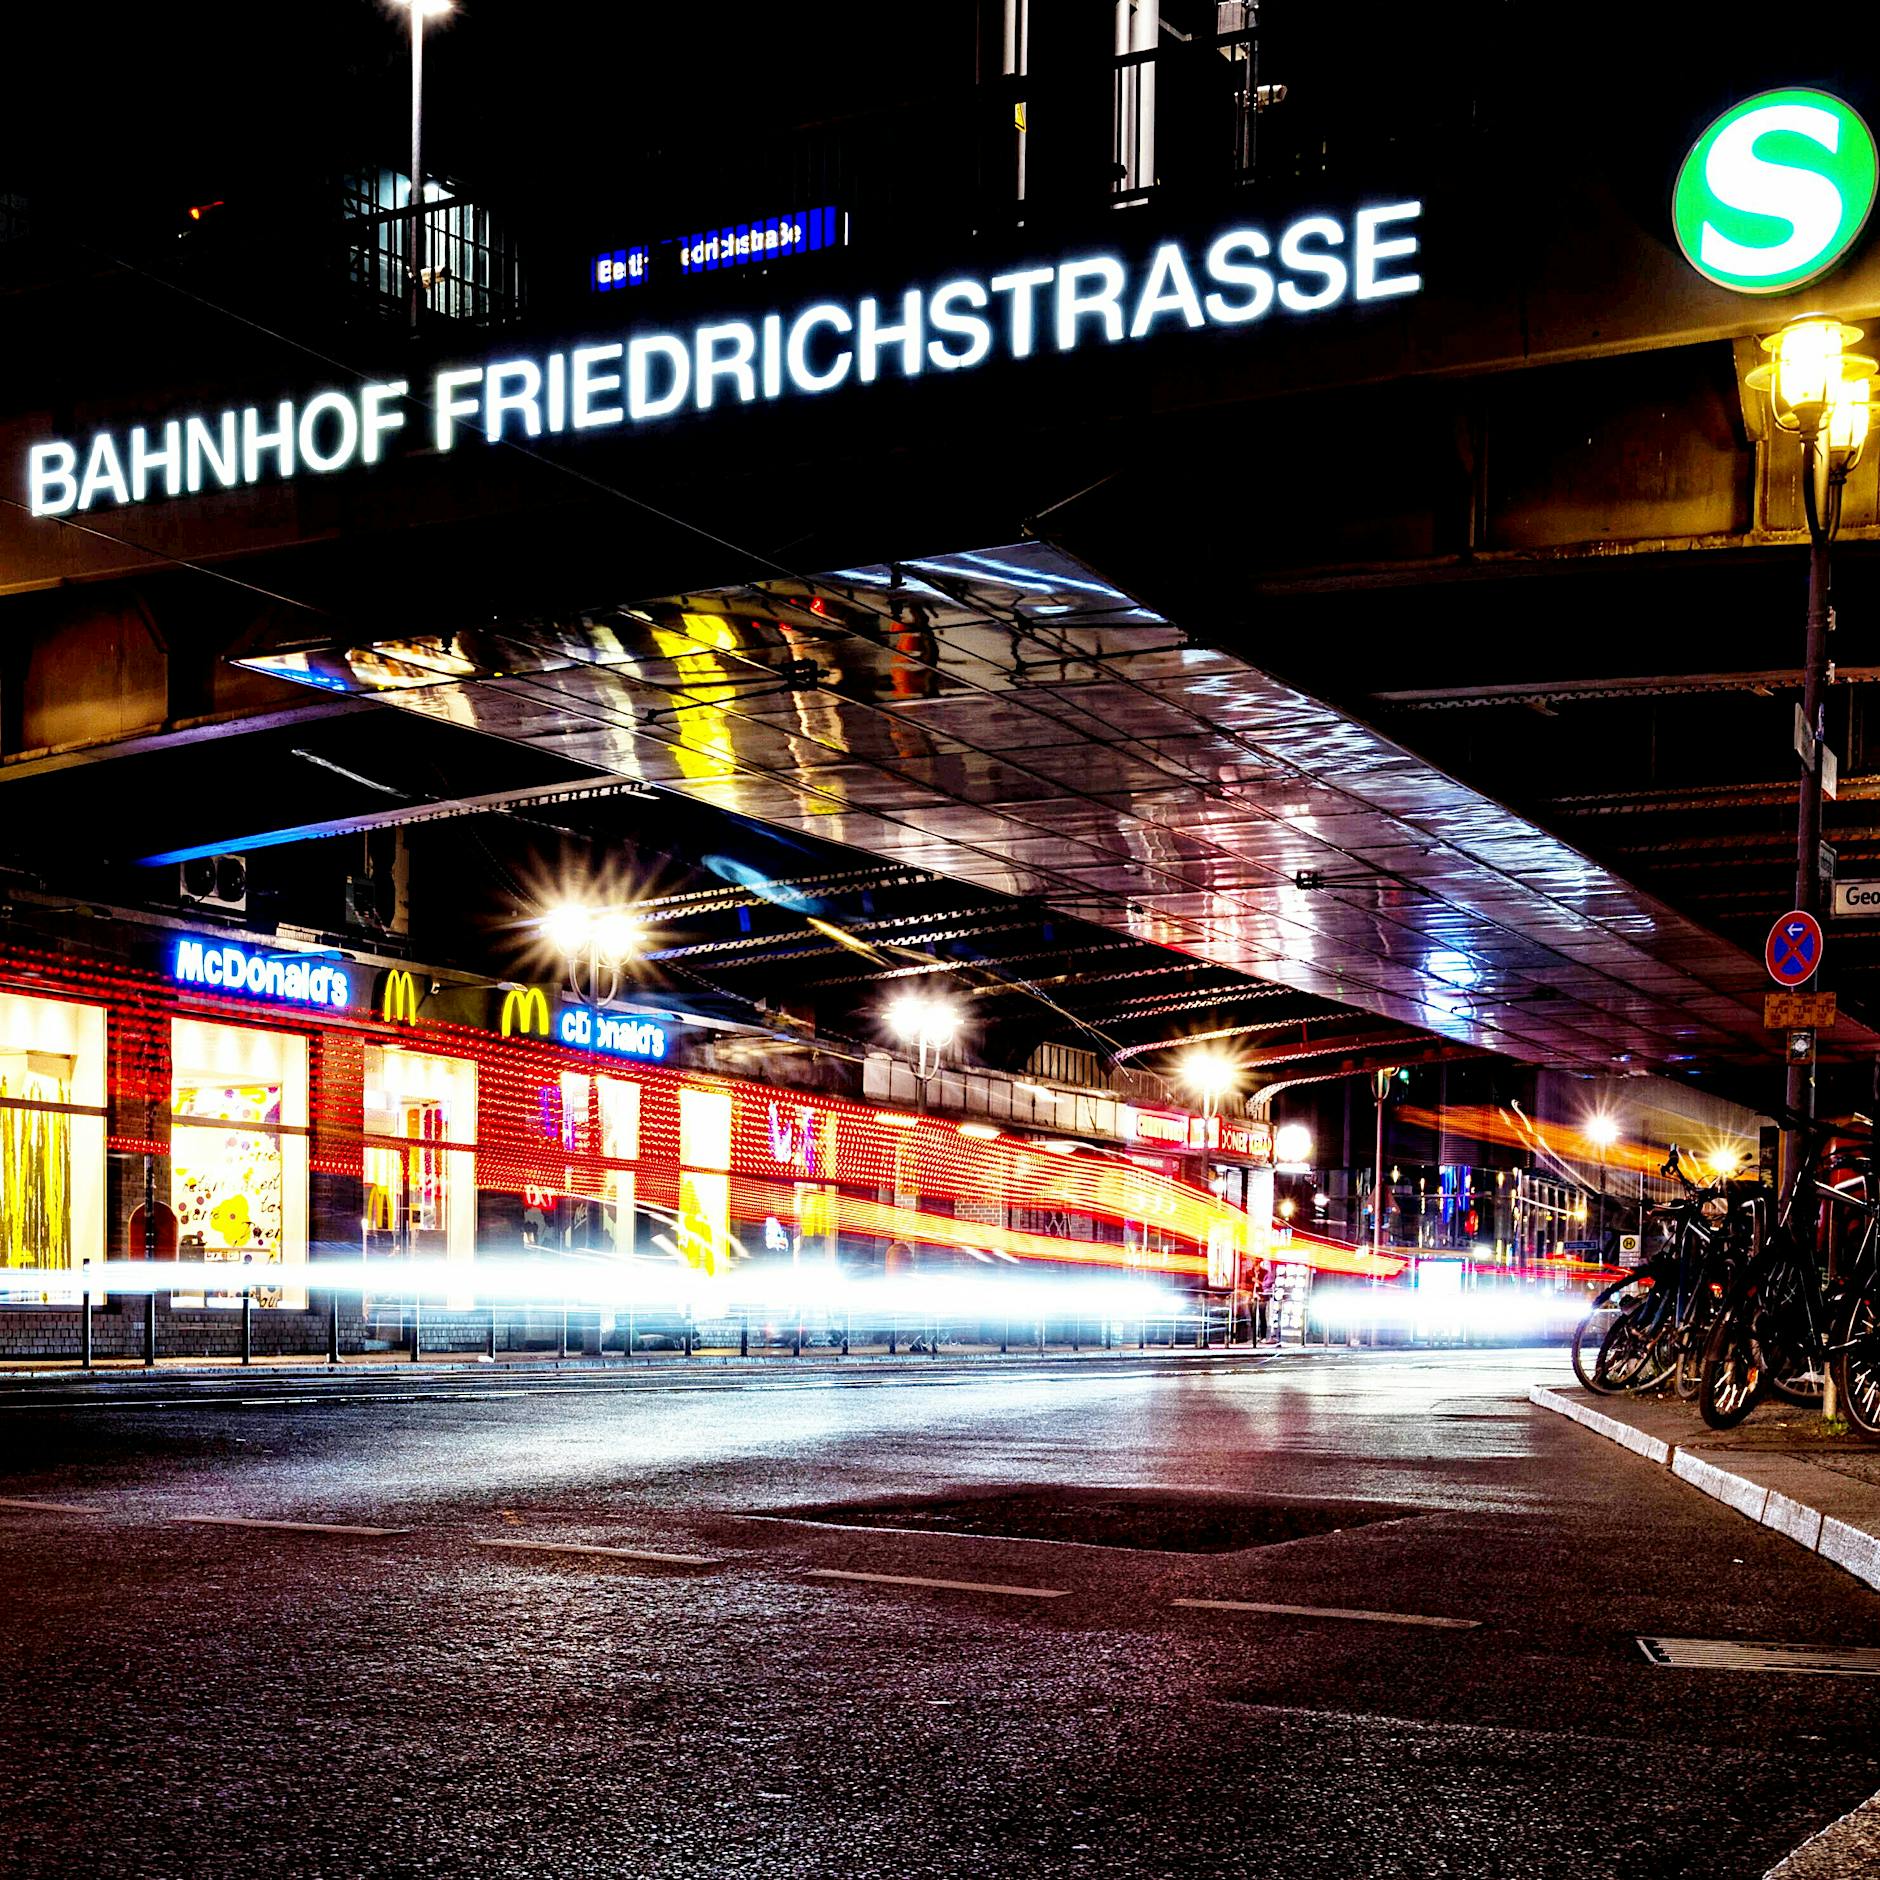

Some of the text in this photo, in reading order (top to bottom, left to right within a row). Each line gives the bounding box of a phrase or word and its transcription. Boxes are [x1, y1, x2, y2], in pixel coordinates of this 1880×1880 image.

[1701, 105, 1843, 276] S
[28, 199, 1422, 518] BAHNHOF FRIEDRICHSTRASSE
[1846, 886, 1880, 906] Geo
[176, 940, 348, 1007] McDonald's
